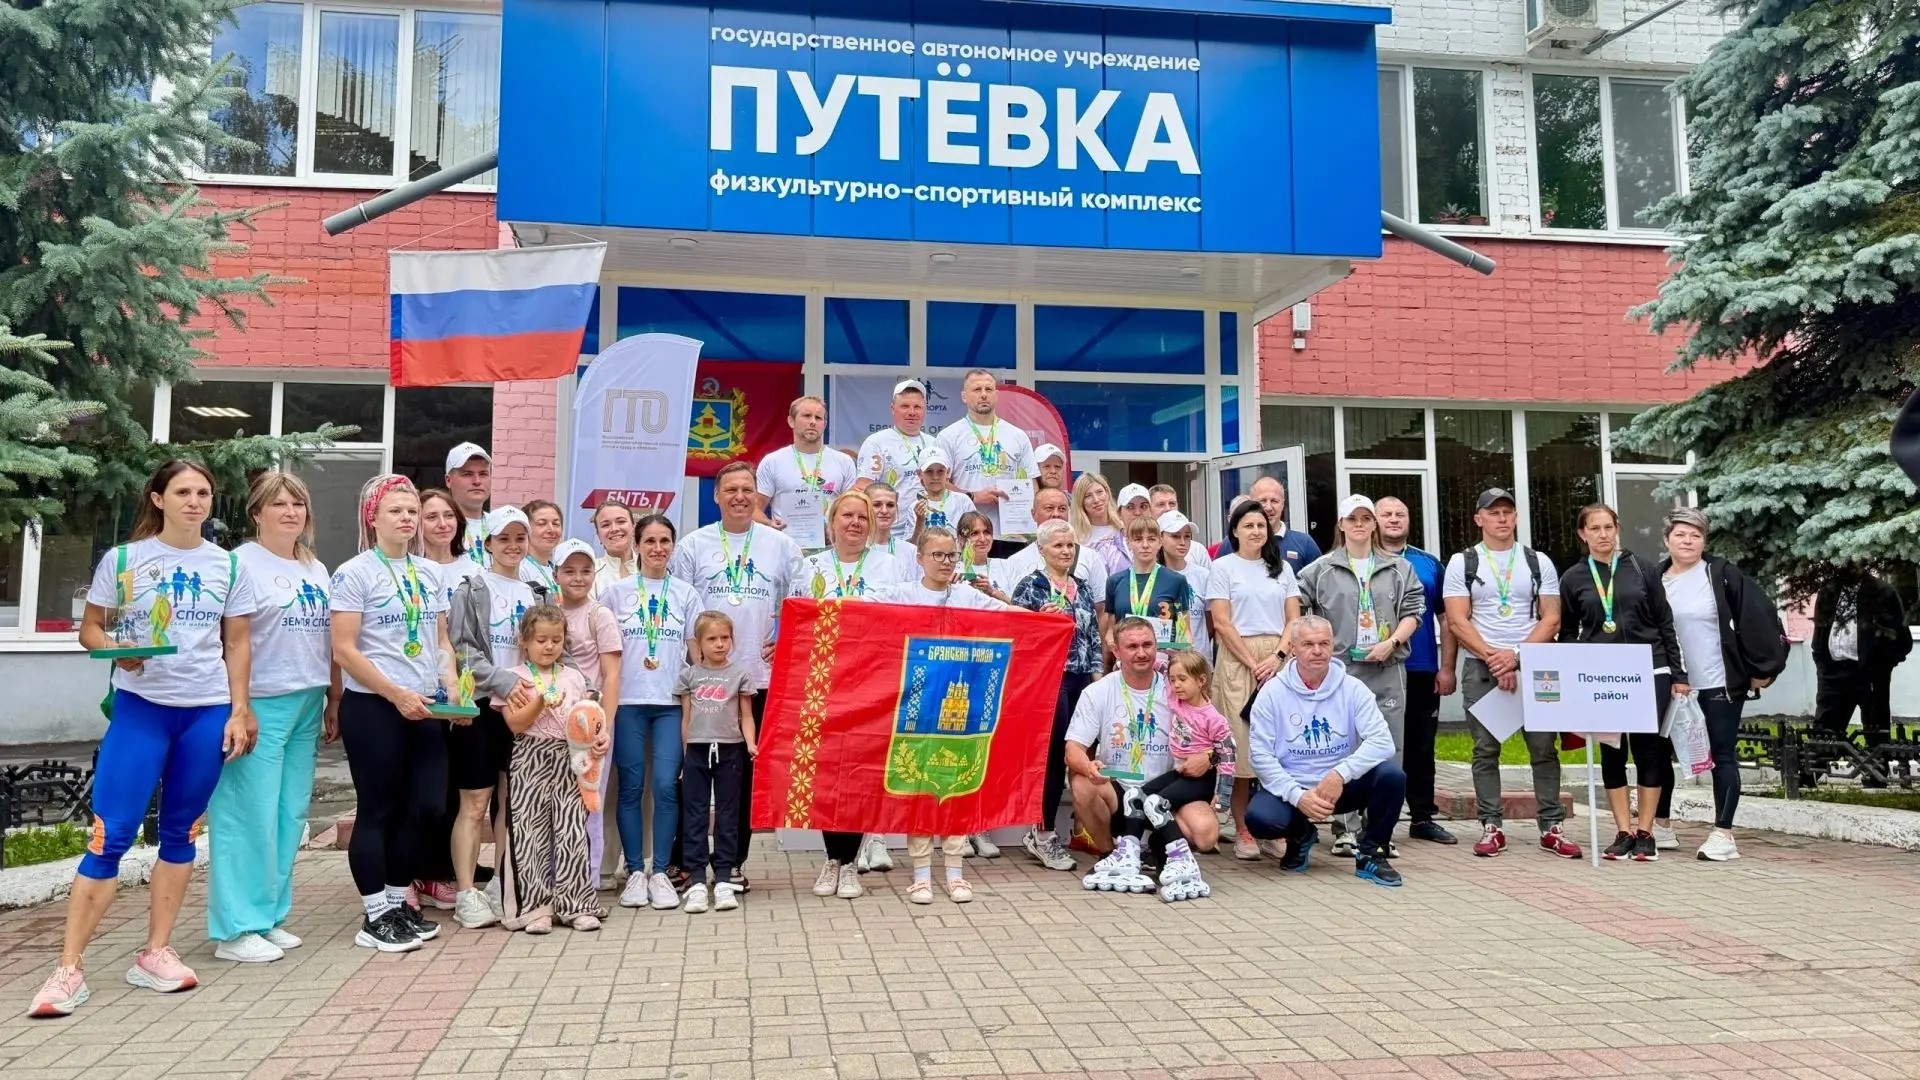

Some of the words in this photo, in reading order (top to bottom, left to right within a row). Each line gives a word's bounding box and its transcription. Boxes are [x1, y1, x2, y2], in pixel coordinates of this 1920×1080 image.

[711, 26, 915, 55] государственное
[921, 41, 1058, 64] автономное
[1063, 49, 1201, 71] учреждение
[710, 62, 1202, 175] ПУТЁВКА
[709, 168, 1074, 208] физкультурно-спортивный
[1080, 191, 1202, 213] комплекс
[602, 389, 670, 434] ГТО
[377, 611, 408, 625] ЗЕМЛ
[1578, 672, 1642, 684] Почепский
[1593, 690, 1629, 702] район
